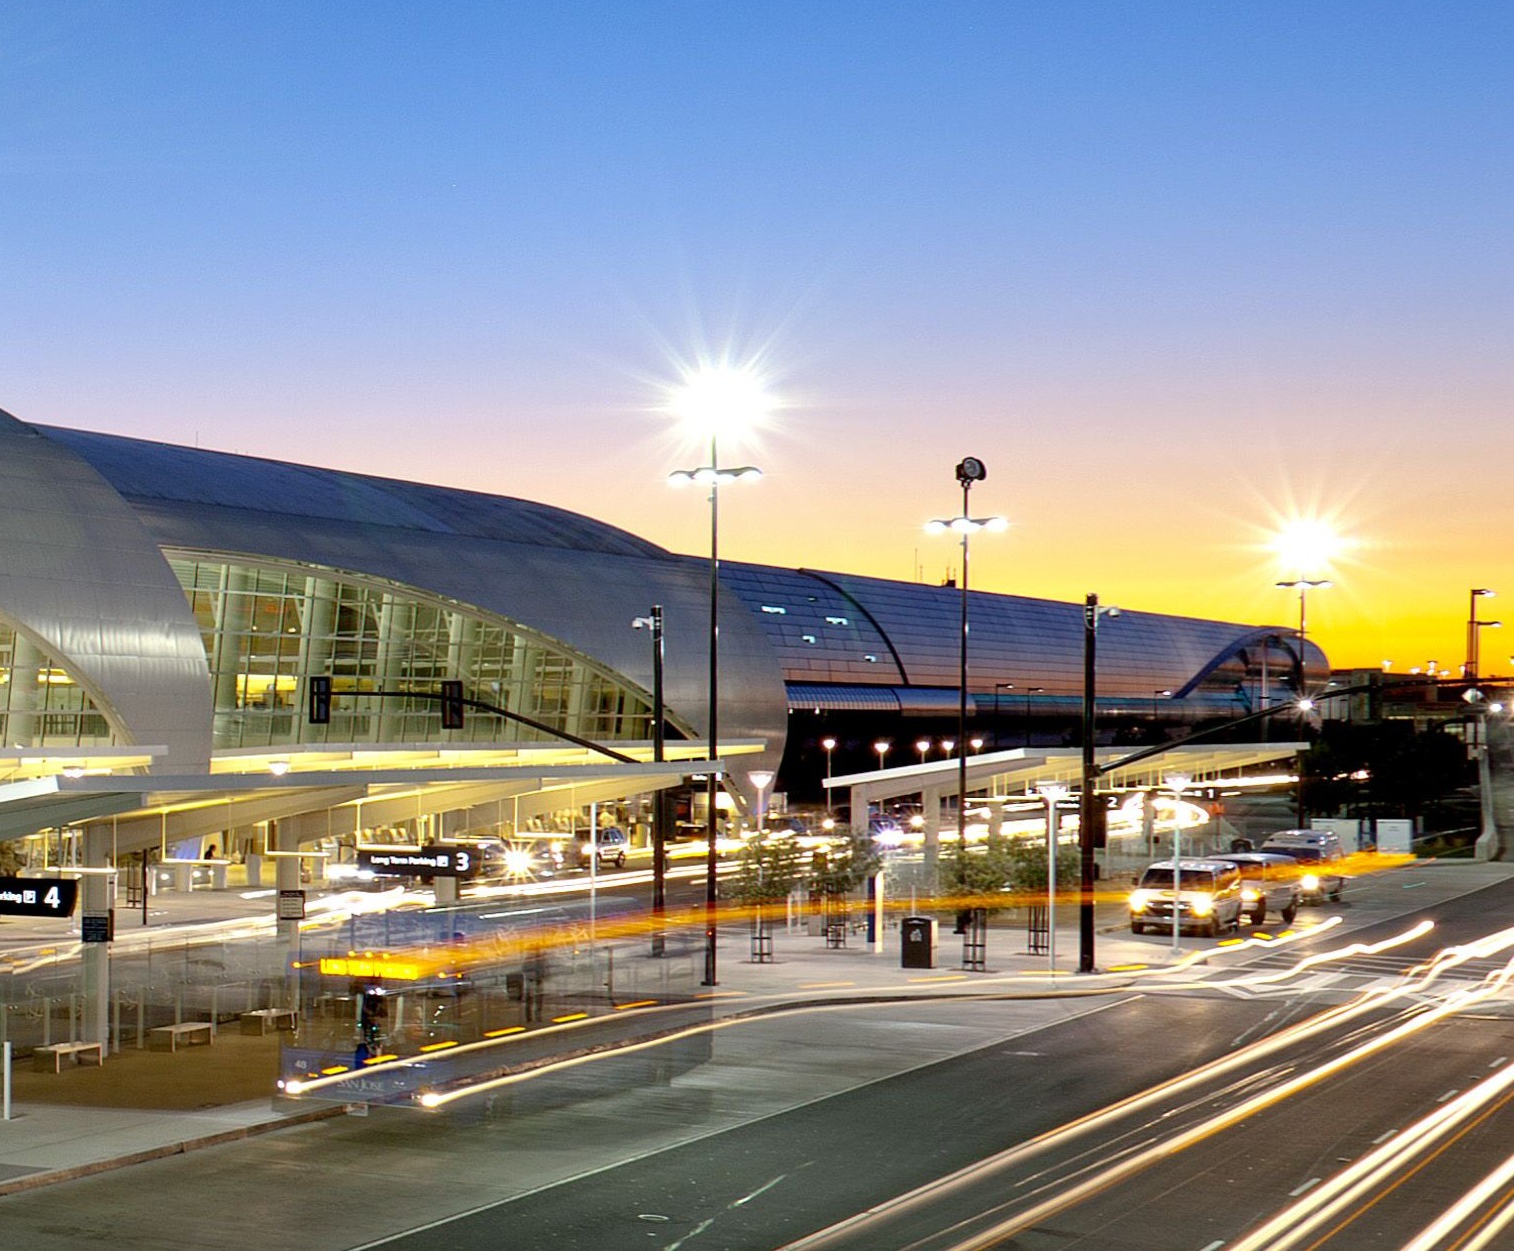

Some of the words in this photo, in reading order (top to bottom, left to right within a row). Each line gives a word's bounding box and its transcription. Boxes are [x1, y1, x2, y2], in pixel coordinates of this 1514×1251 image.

[1106, 796, 1118, 808] 2
[371, 856, 389, 866] Long
[409, 856, 436, 867] Parking
[455, 851, 469, 871] 3
[43, 886, 61, 909] 4
